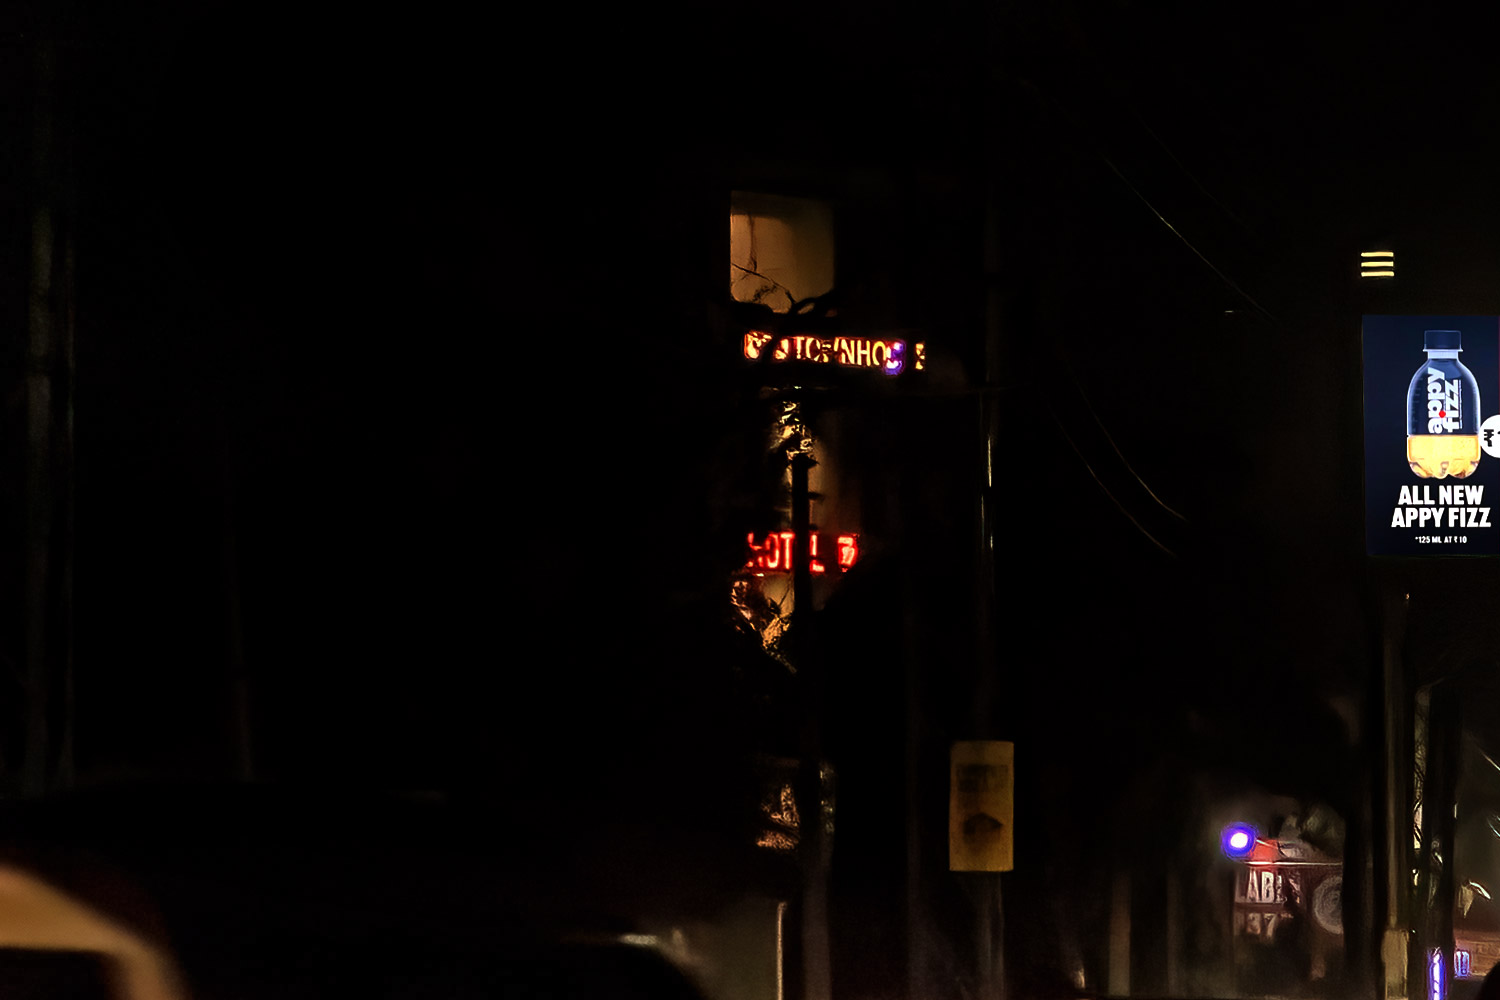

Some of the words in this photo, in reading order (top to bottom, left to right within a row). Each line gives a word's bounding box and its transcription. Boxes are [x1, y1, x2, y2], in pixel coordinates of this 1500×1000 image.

[1398, 485, 1435, 505] ALL
[1438, 485, 1484, 505] NEW
[1391, 507, 1445, 528] APPY
[1448, 507, 1491, 528] FIZZ
